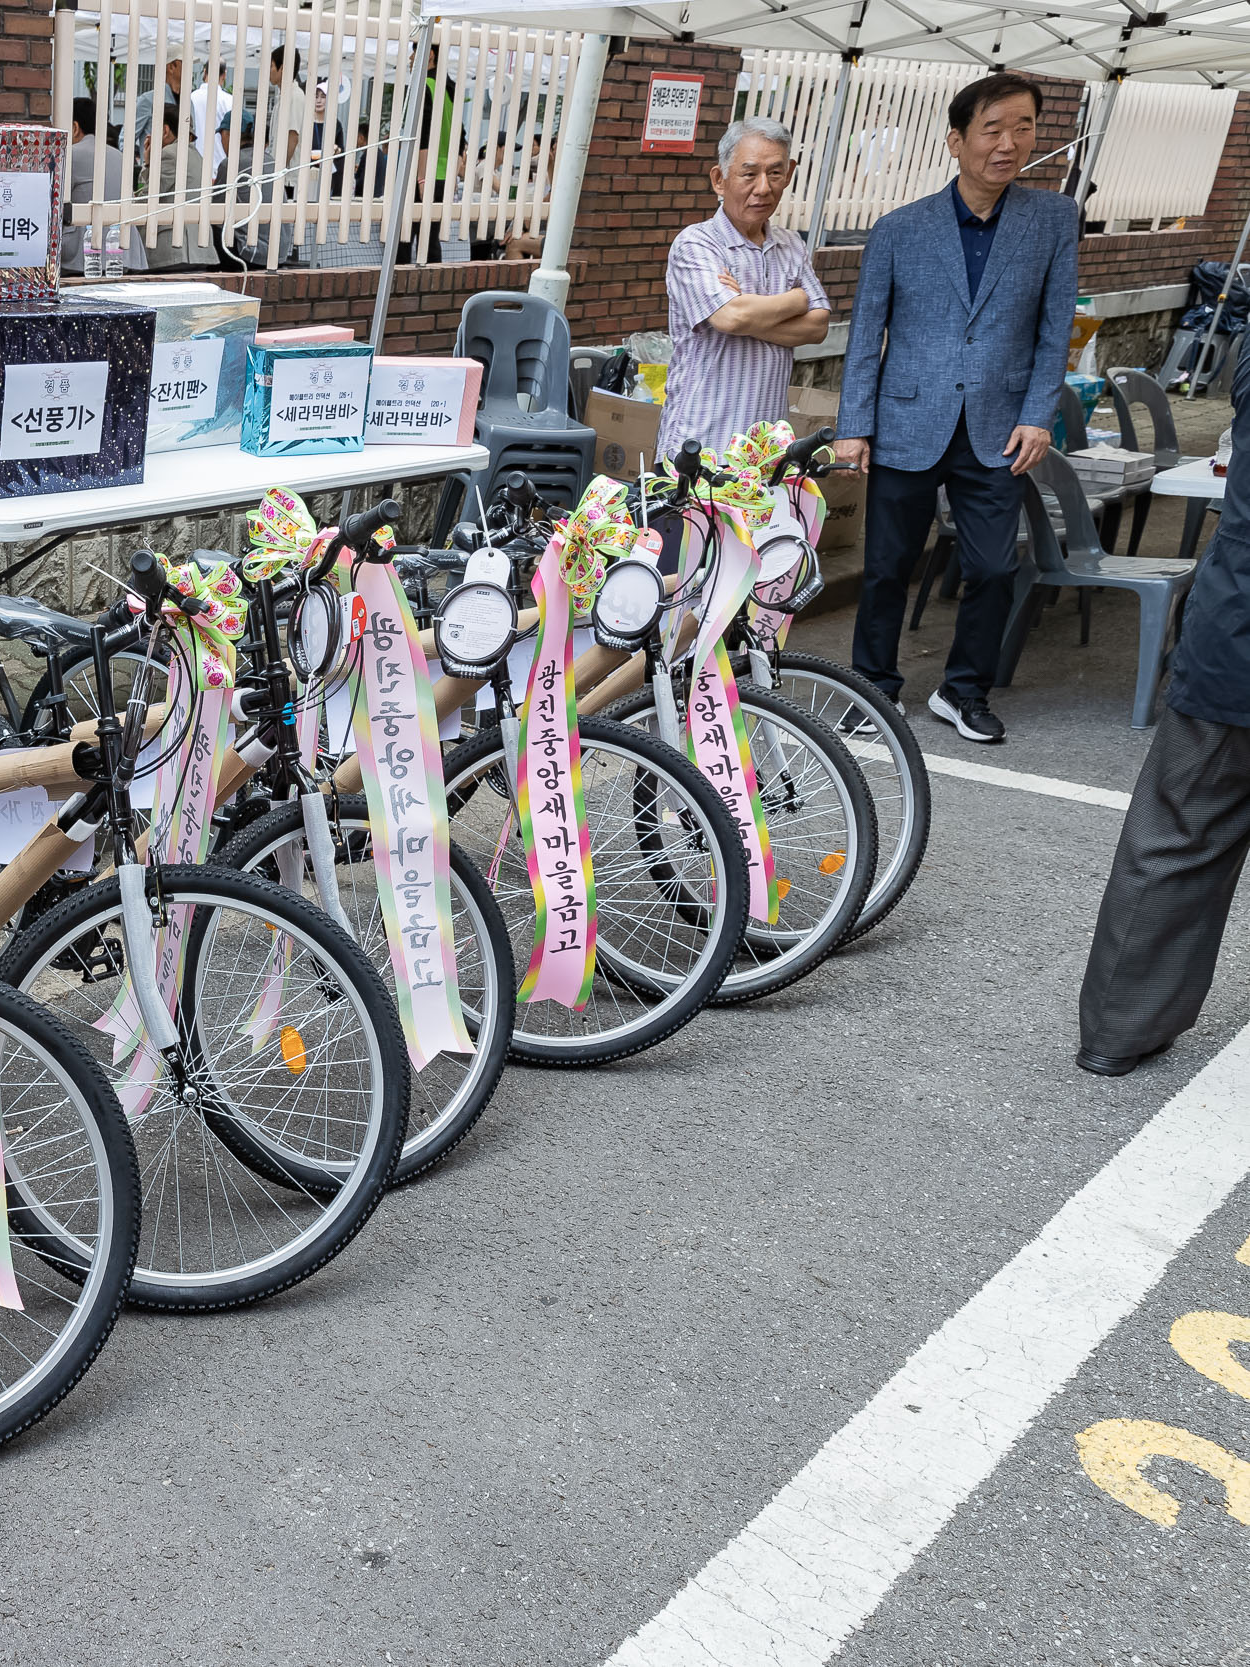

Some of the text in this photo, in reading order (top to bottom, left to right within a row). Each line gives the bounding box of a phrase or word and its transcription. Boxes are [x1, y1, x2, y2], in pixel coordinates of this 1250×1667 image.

[150, 379, 208, 402] <잔치팬>
[11, 405, 95, 433] <선풍기>
[276, 403, 358, 422] <세라믹냄비>
[531, 659, 581, 954] 광진중앙새마을금고
